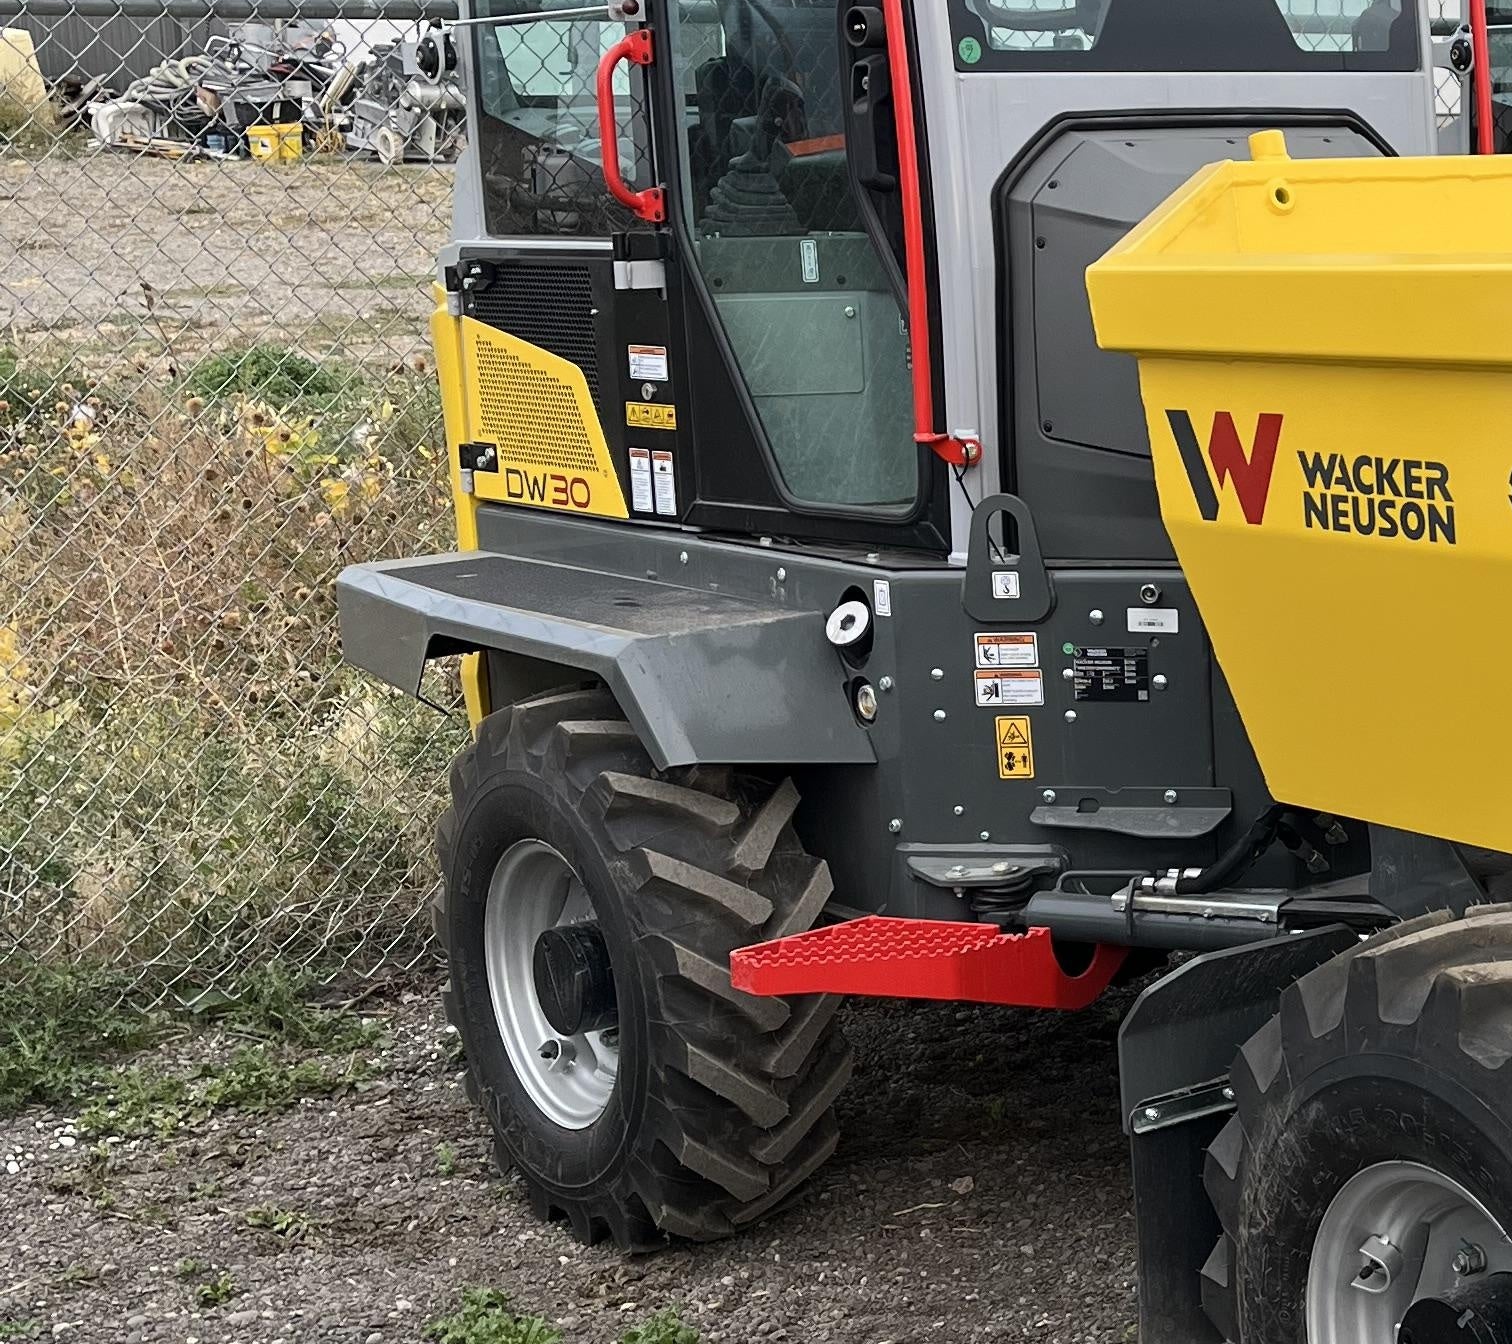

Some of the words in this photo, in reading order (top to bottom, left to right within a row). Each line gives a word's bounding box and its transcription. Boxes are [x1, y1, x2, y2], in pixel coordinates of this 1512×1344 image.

[505, 467, 591, 509] DW30
[1296, 449, 1456, 503] WACKER
[1302, 490, 1458, 545] NEUSON
